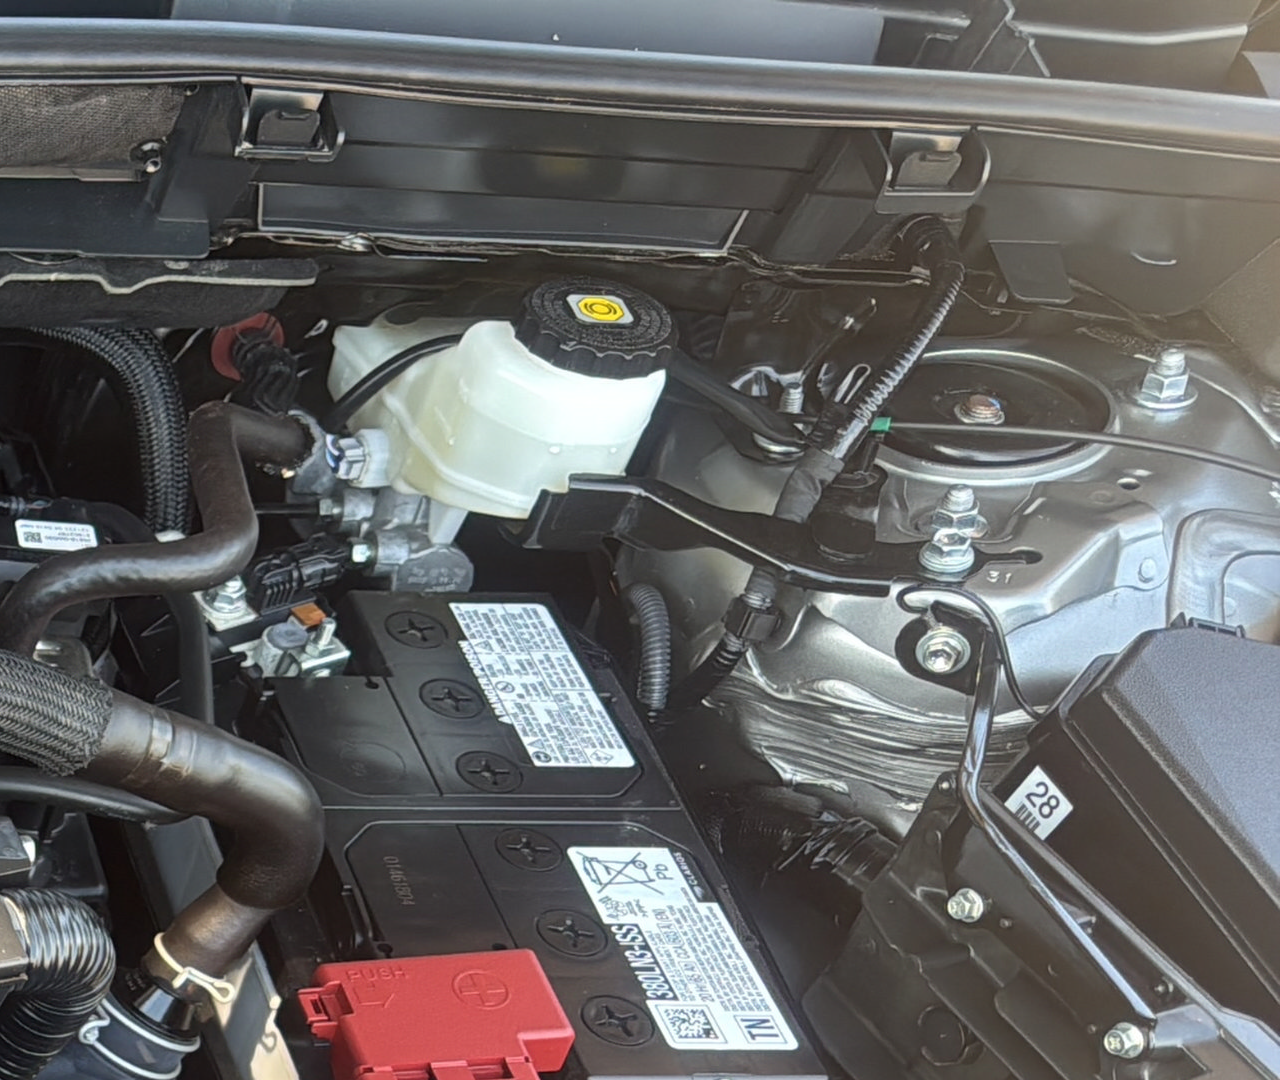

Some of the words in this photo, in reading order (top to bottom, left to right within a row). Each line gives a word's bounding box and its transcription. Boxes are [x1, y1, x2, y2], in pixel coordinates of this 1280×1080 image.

[1023, 780, 1060, 821] 28
[650, 863, 674, 879] Pb
[611, 925, 673, 999] 380LN3-ISS
[345, 966, 409, 983] PUSH
[740, 1018, 780, 1040] TN
